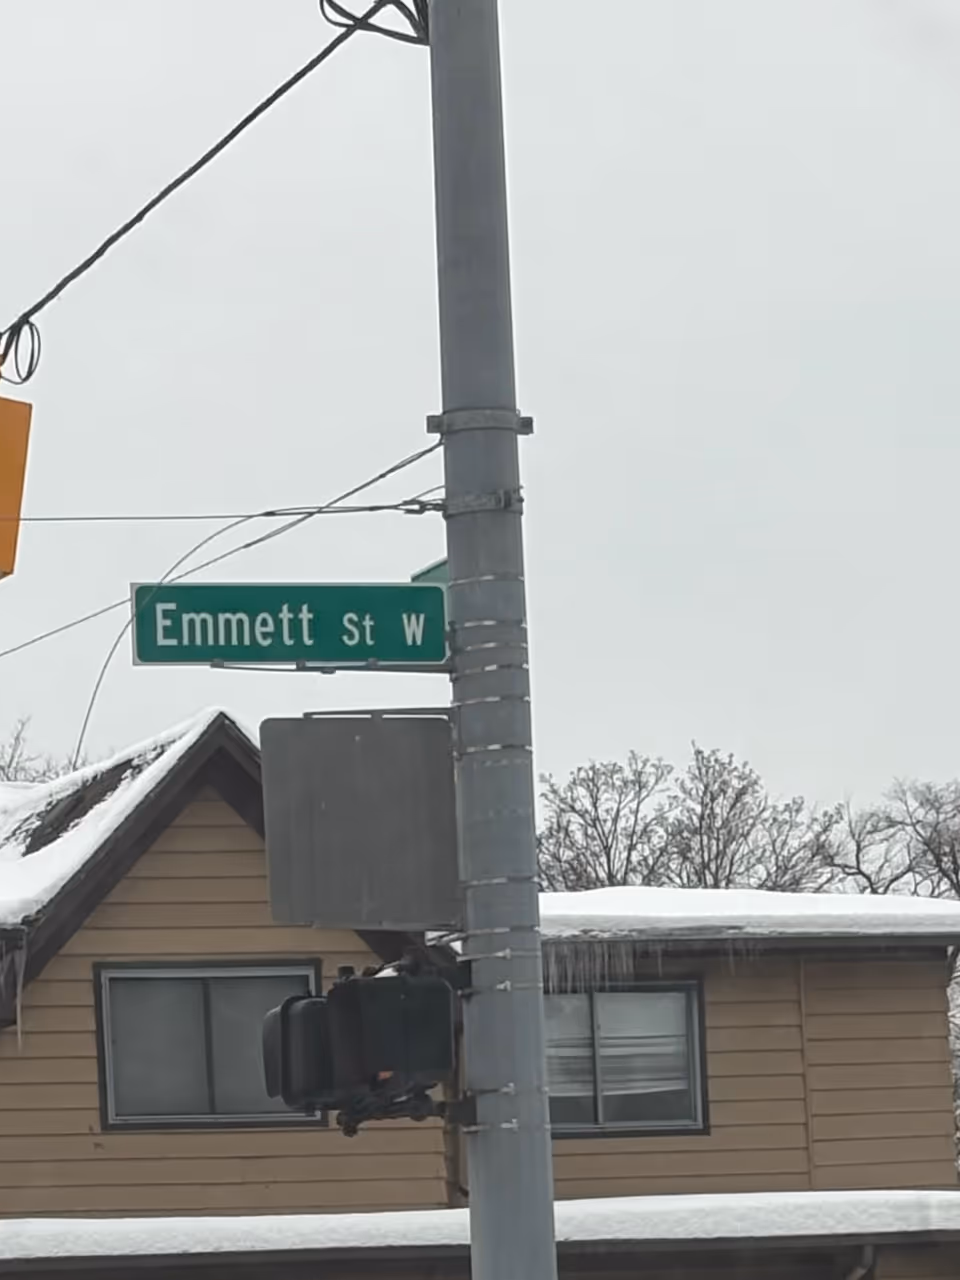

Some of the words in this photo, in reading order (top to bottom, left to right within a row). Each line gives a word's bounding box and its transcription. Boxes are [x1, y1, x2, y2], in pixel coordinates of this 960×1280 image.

[155, 602, 314, 647] Emmett
[342, 612, 375, 646] St
[402, 613, 425, 647] W
